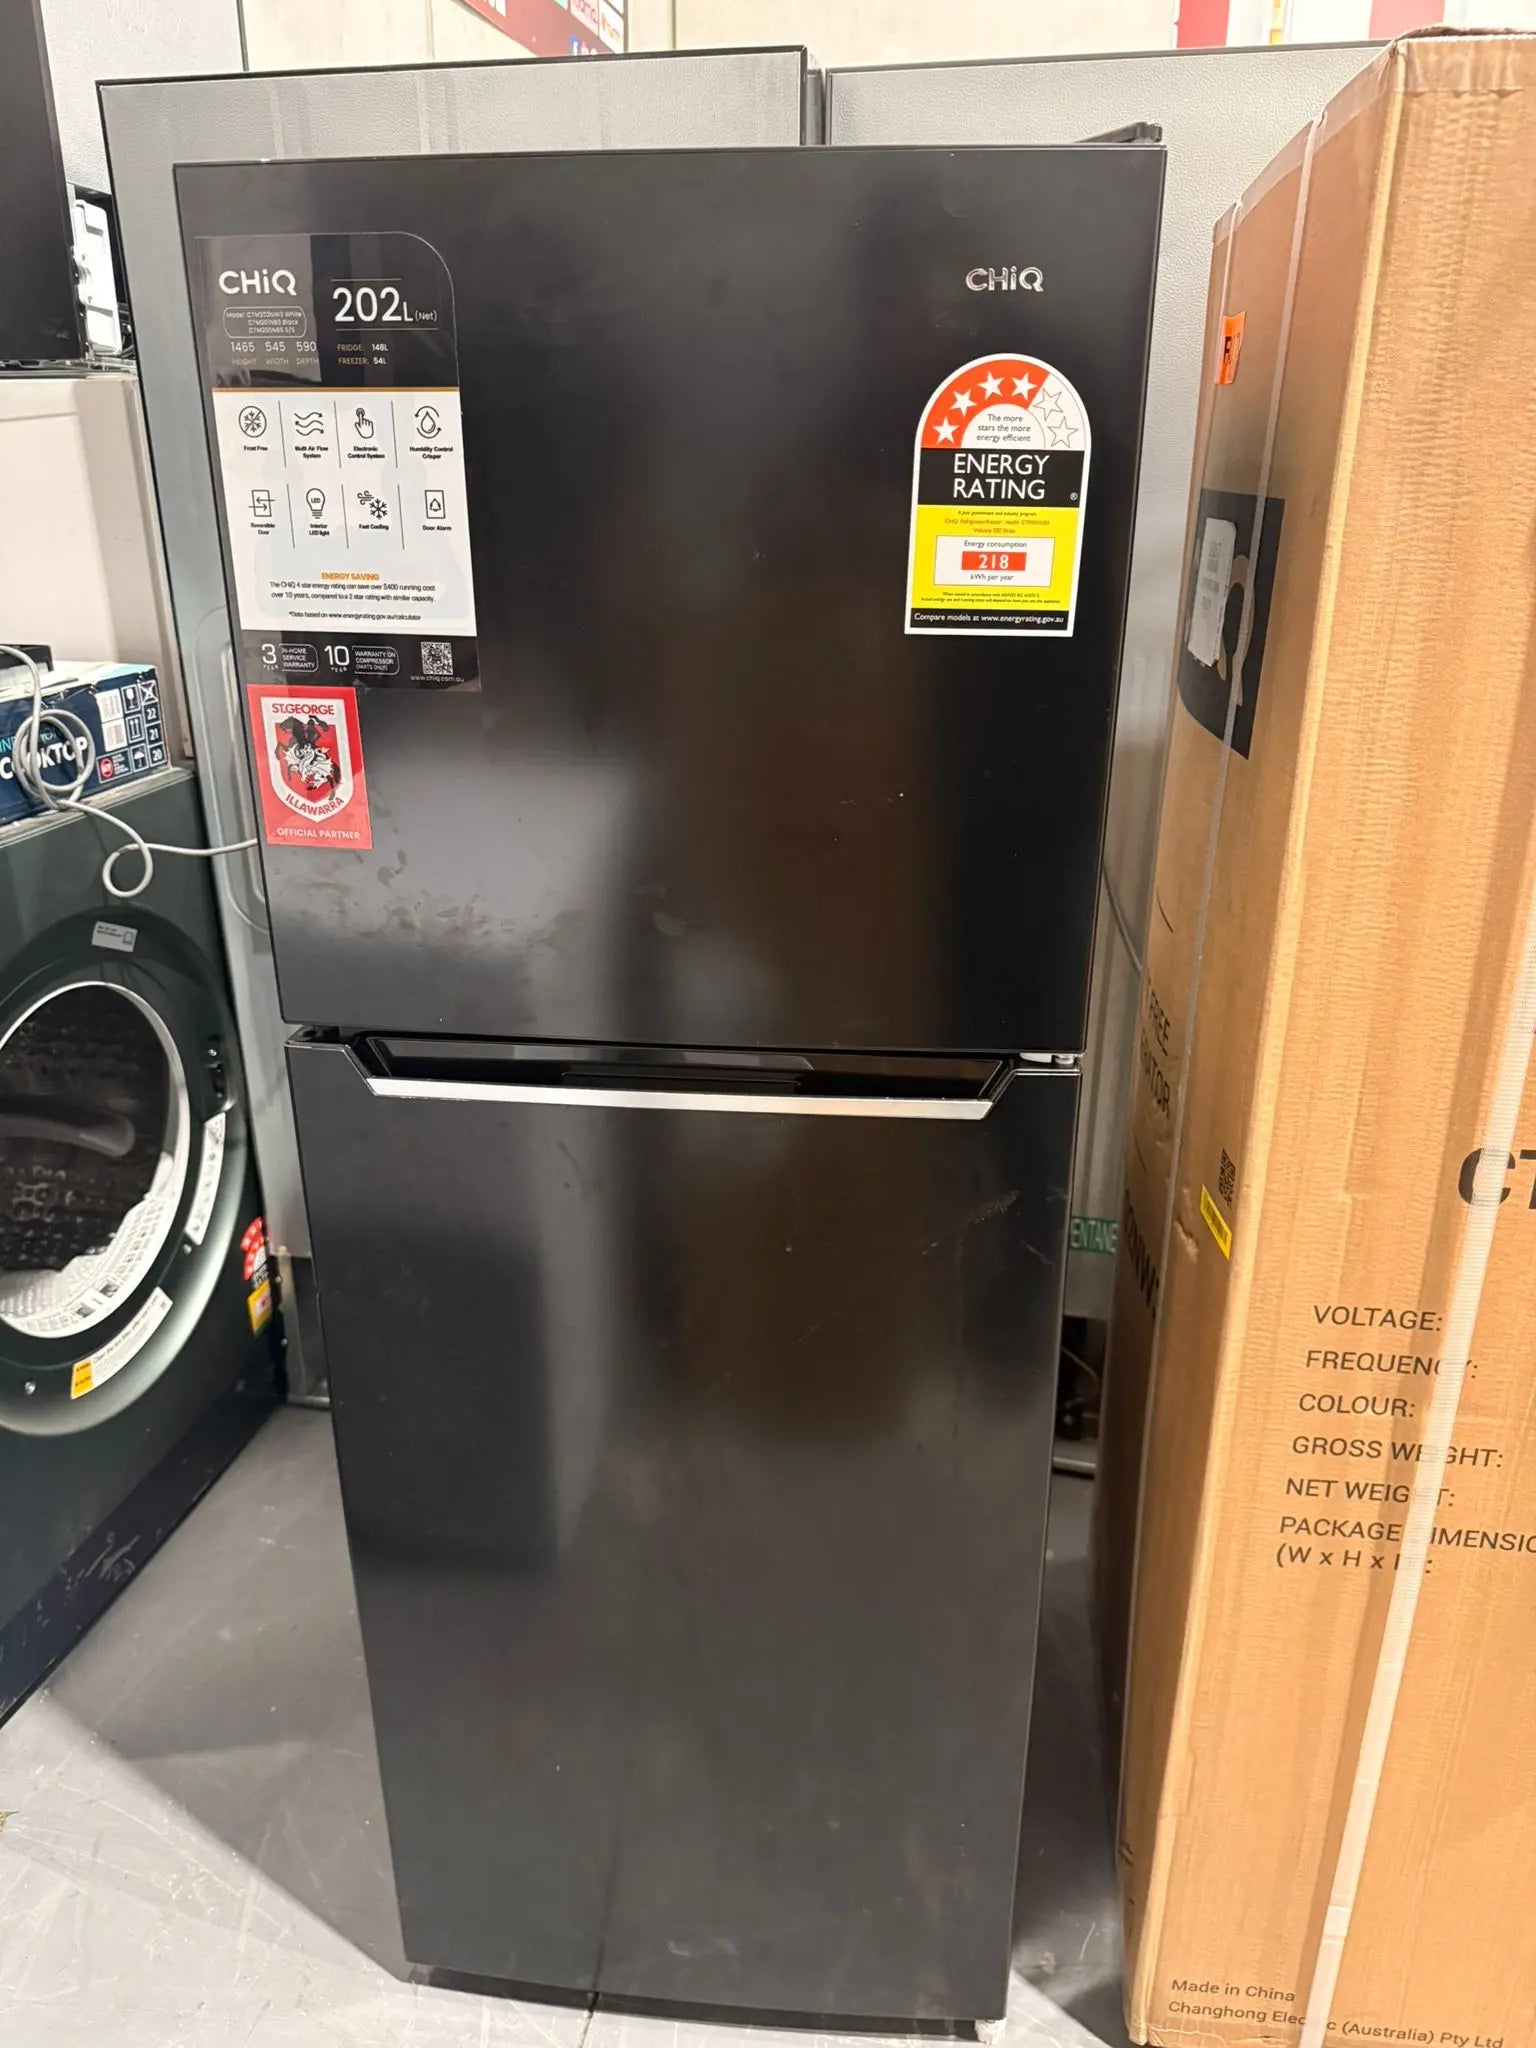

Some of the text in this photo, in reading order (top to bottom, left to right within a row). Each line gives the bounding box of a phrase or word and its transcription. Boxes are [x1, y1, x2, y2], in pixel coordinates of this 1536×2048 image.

[219, 269, 297, 295] CHiQ
[966, 266, 1043, 291] CHiQ
[332, 287, 437, 322] 202L (Net)
[230, 341, 316, 352] 1465 545 590
[296, 357, 319, 365] DEPTH
[373, 357, 387, 365] 54L
[987, 413, 1001, 422] The
[997, 424, 1009, 432] the
[976, 433, 1030, 443] energy efficient
[953, 453, 1049, 475] ENERGY
[953, 478, 1046, 500] RATING
[964, 540, 1027, 549] Energy consumption
[978, 554, 1009, 569] 218
[351, 573, 379, 581] SAVING
[970, 573, 1014, 583] kWh per year
[914, 613, 945, 622] Compare
[947, 613, 971, 622] models
[981, 615, 1064, 625] www.energyrating.gov.au
[262, 643, 276, 664] 3
[324, 645, 350, 666] 10
[146, 707, 157, 720] 22
[272, 703, 334, 715] ST.GEORGE
[149, 728, 159, 740] 21
[152, 748, 163, 761] 20
[285, 793, 344, 816] ILLAWARRA
[276, 827, 360, 840] OFFICIAL PARTNER
[1312, 1304, 1443, 1332] VOLTAGE:
[1299, 1393, 1415, 1418] COLOUR:
[1292, 1436, 1382, 1459] GROSS
[1286, 1478, 1455, 1507] NET WEIGT:
[1280, 1516, 1402, 1542] PACKAGE
[1276, 1542, 1312, 1568] (W
[1319, 1551, 1333, 1566] x
[1343, 1550, 1361, 1568] H
[1370, 1554, 1385, 1570] x
[1171, 1979, 1295, 2002] Made in China
[1168, 2000, 1267, 2023] Changhong
[1342, 2020, 1434, 2044] (Australia)
[1439, 2031, 1470, 2047] Pty
[1474, 2035, 1504, 2048] Ltd
